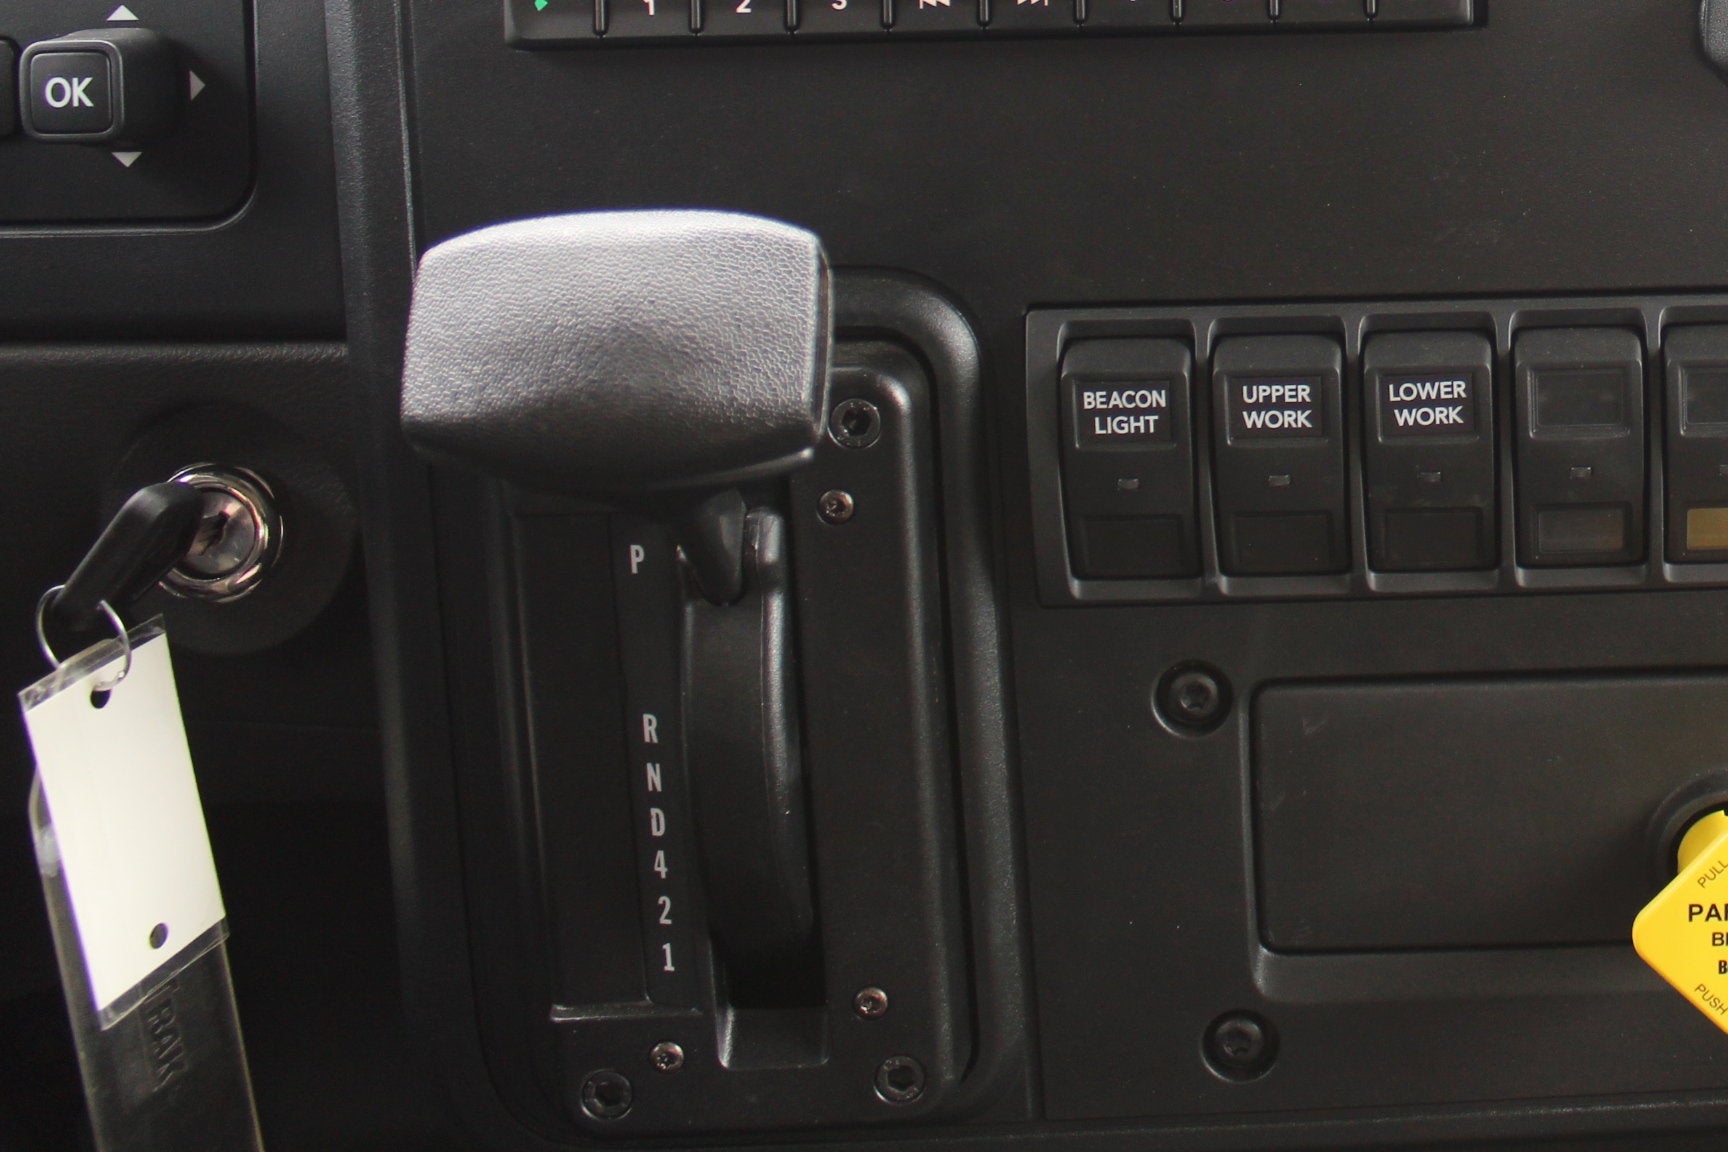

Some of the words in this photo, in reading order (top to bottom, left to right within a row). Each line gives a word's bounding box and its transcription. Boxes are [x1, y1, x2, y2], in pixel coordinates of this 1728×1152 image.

[44, 76, 94, 108] OK
[1083, 389, 1166, 410] BEACON
[1242, 384, 1311, 404] UPPER
[1388, 380, 1467, 402] LOWER
[1094, 415, 1159, 435] LIGHT
[1242, 409, 1313, 429] WORK
[1393, 405, 1464, 427] WORK
[630, 544, 645, 574] P
[642, 713, 658, 744] R
[646, 762, 662, 792] N
[650, 807, 666, 837] D
[654, 850, 668, 879] 4
[658, 895, 672, 925] 2
[662, 942, 675, 972] 1
[1694, 983, 1728, 1016] PUSH
